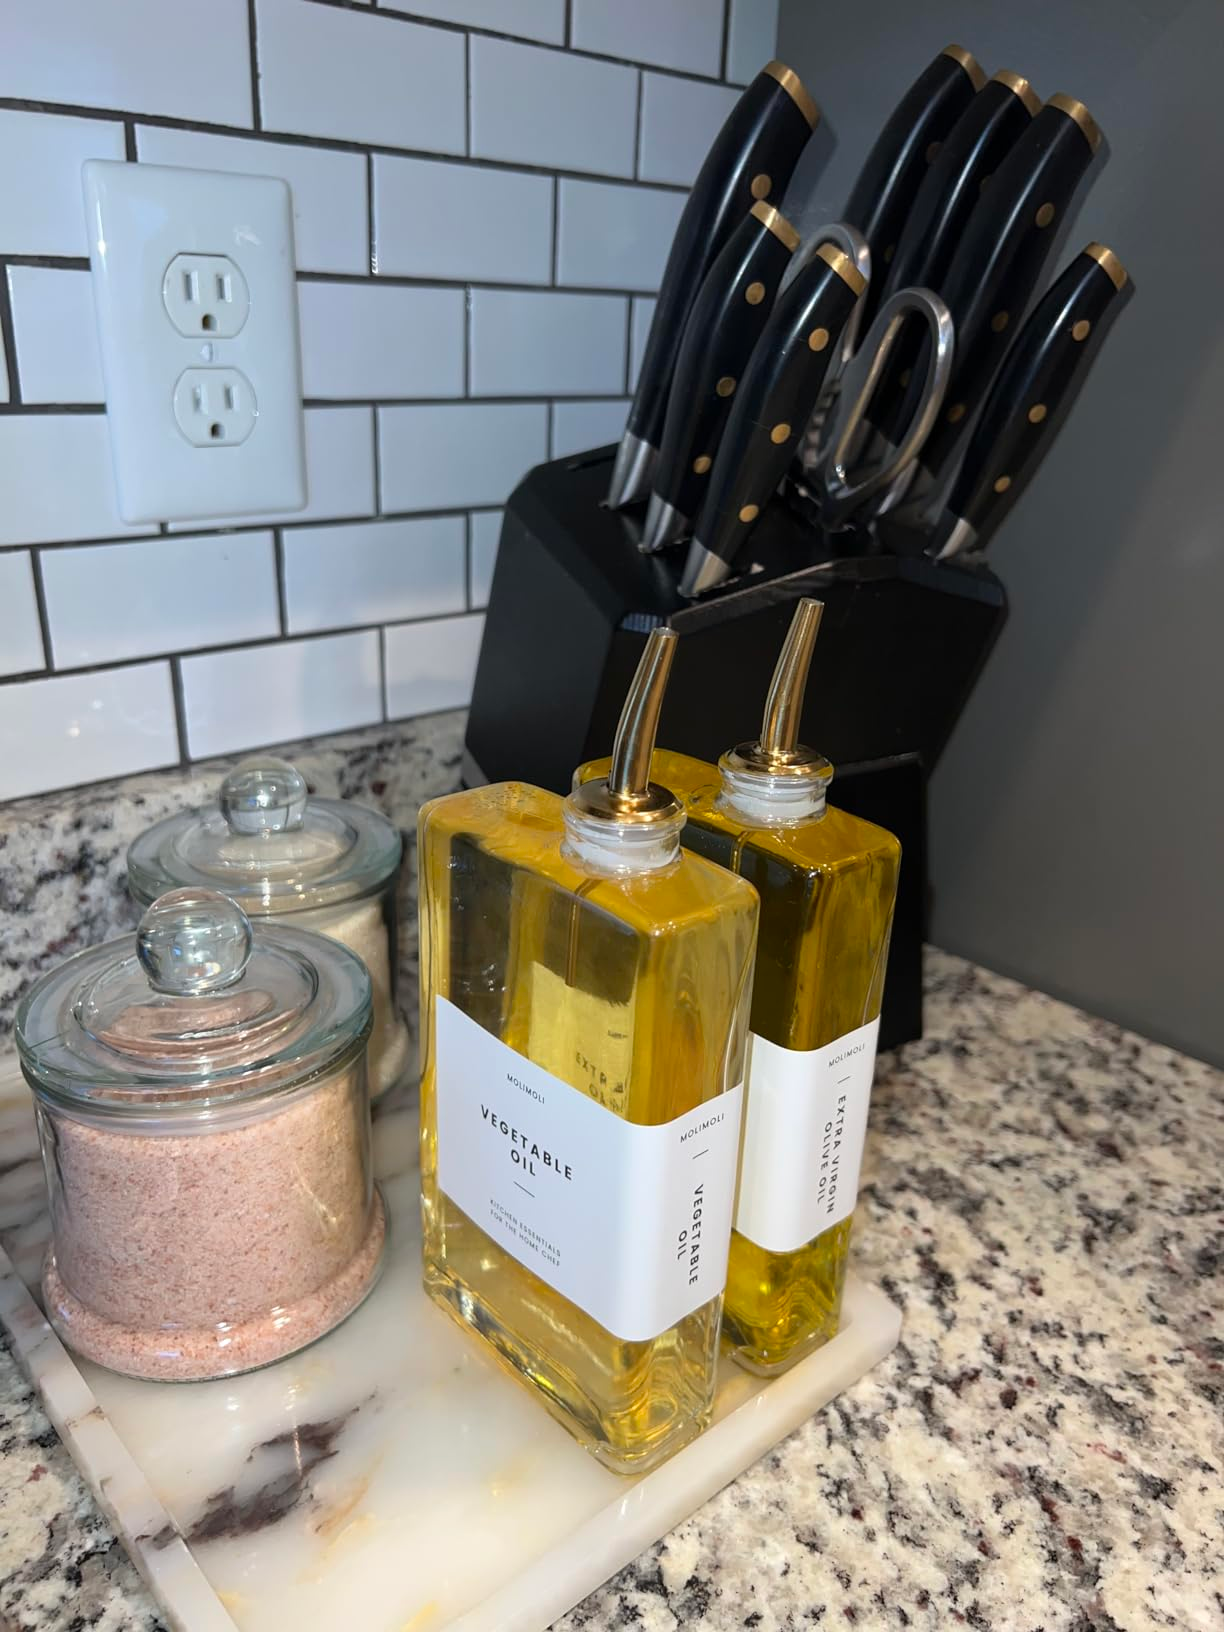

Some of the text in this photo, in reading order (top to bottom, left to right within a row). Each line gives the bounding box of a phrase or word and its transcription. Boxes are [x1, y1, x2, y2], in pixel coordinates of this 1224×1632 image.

[828, 1044, 865, 1068] MOLIMOLI
[507, 1073, 545, 1104] MOLIMOLI
[481, 1103, 572, 1181] VEGETABLE
[680, 1113, 725, 1143] MOLIMOLI
[826, 1095, 847, 1214] EXTRA VIRGIN
[510, 1148, 536, 1176] OIL
[817, 1121, 833, 1204] OLIVE OIL
[489, 1199, 561, 1257] KITCHEN ESSENTIALS
[490, 1209, 560, 1267] FOR THE HOME CHEF
[677, 1230, 688, 1260] OIL
[689, 1184, 704, 1286] VEGETABLE
